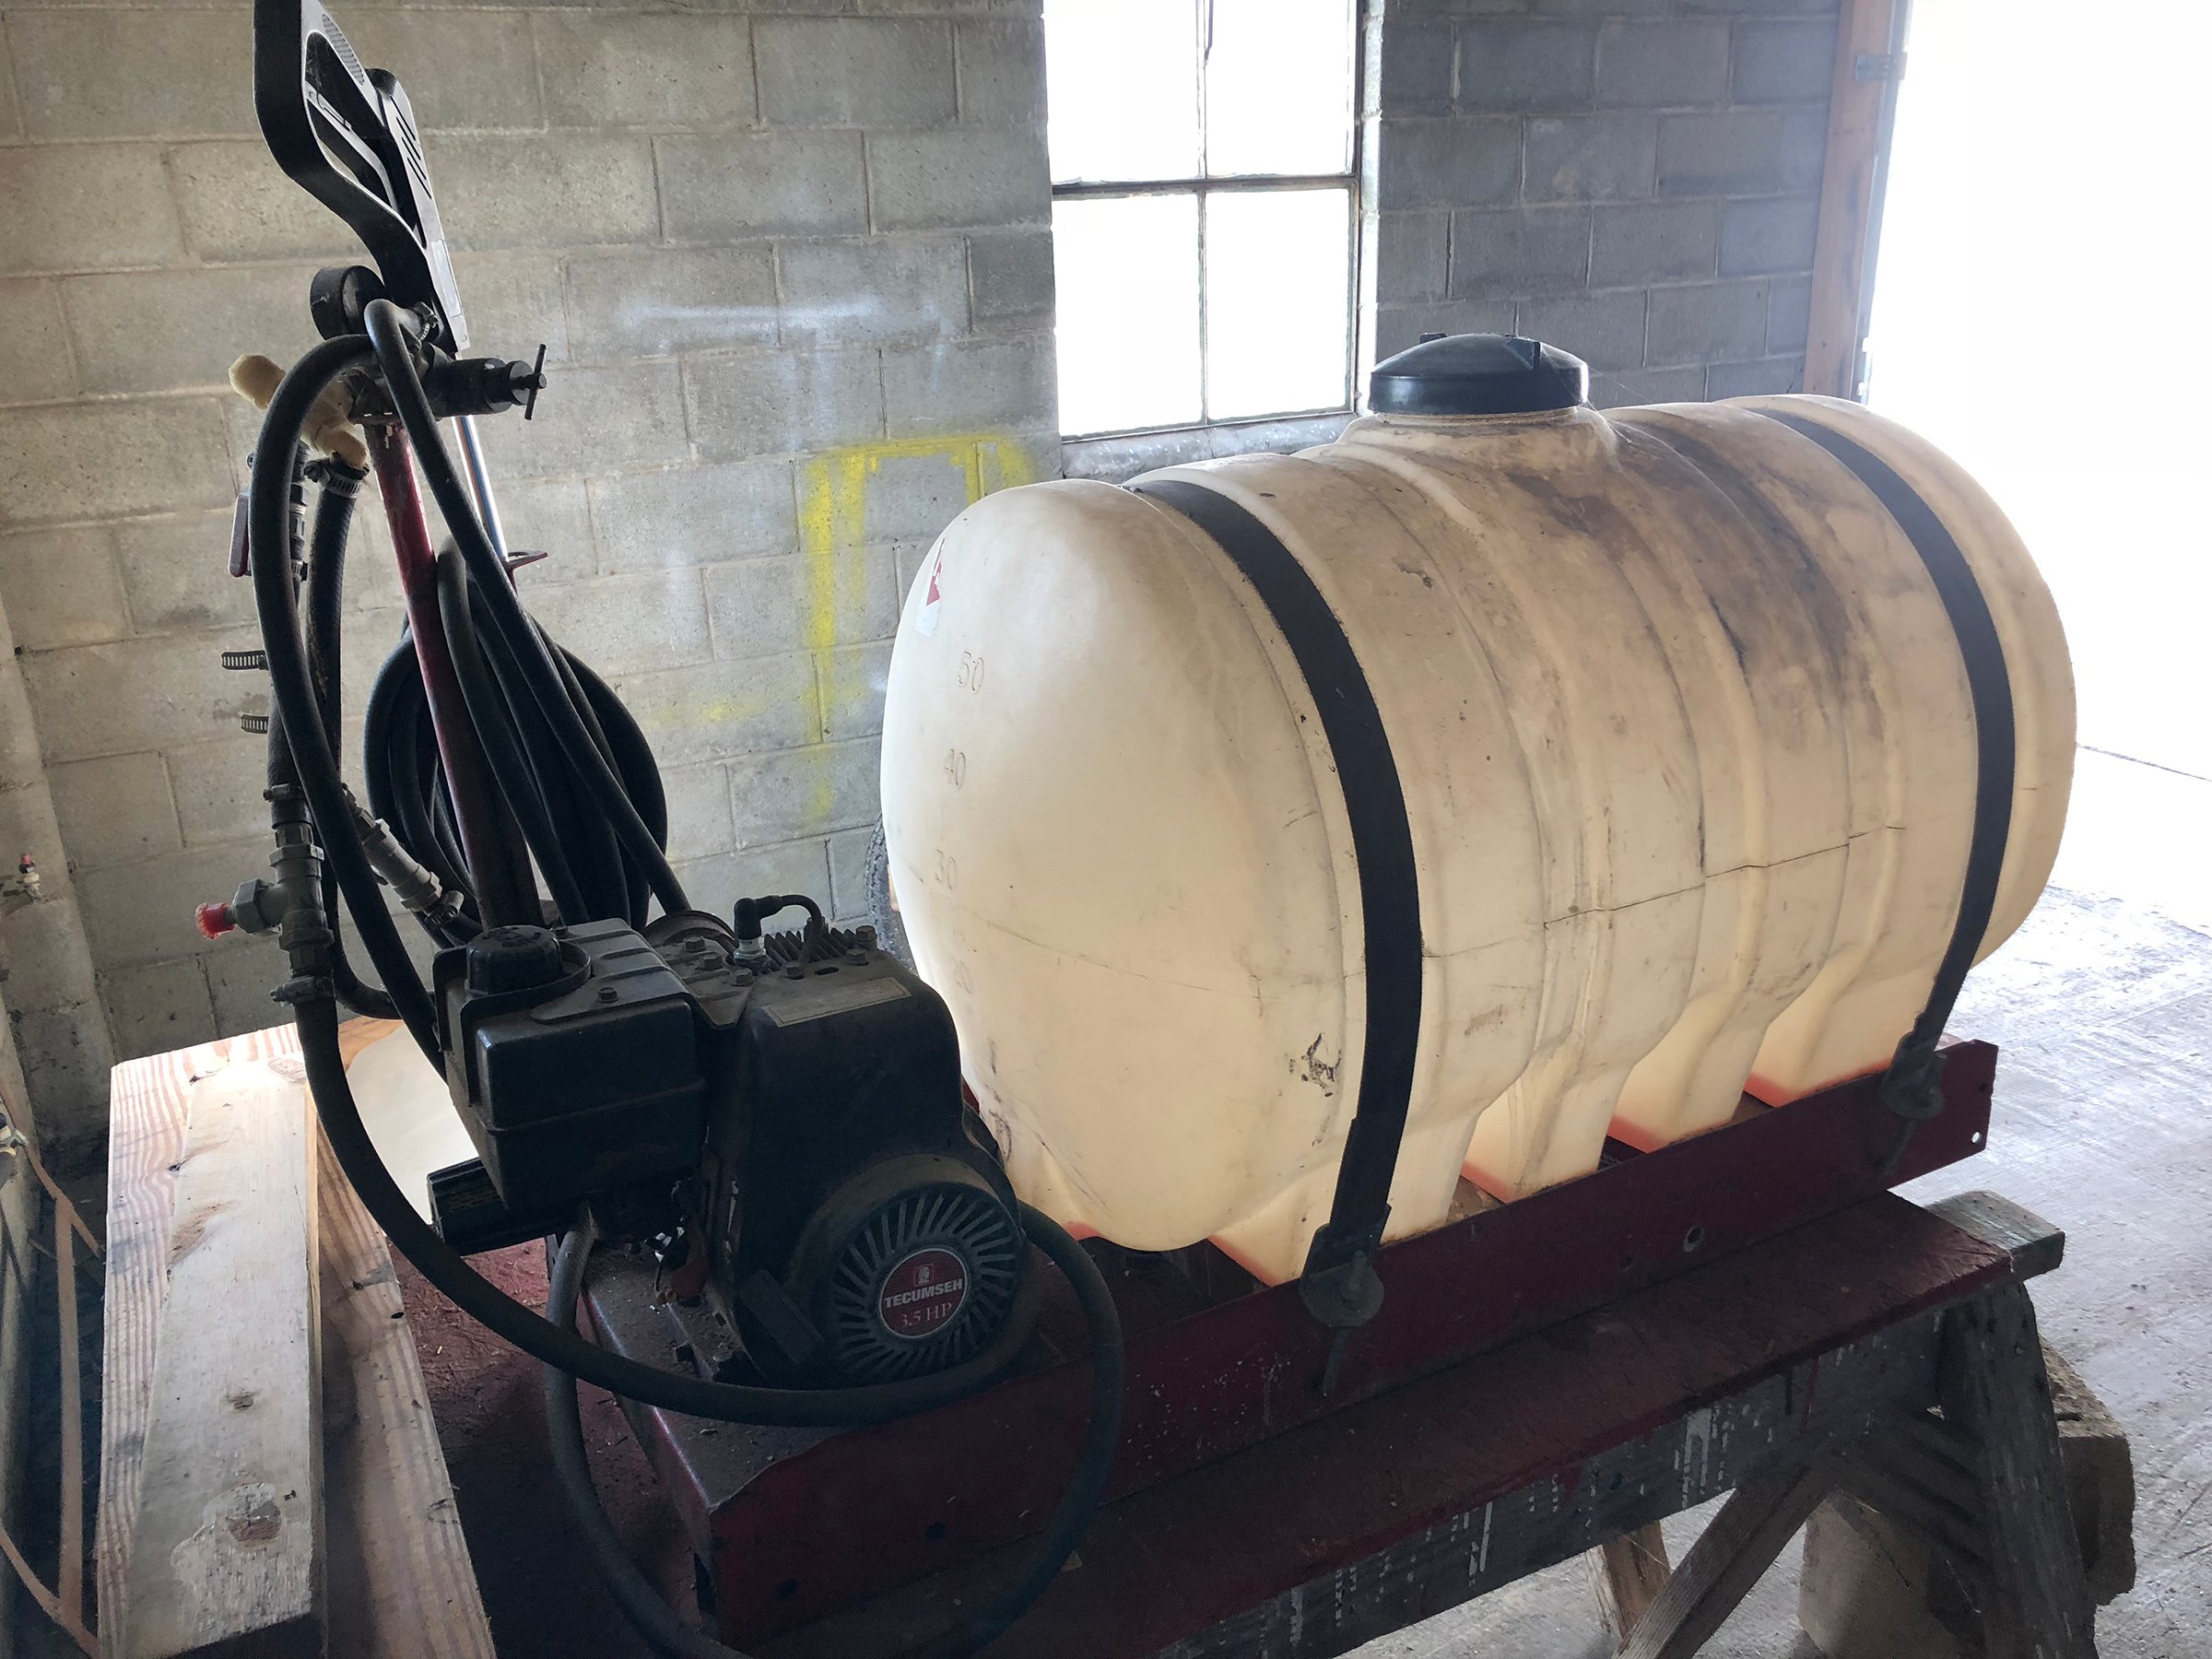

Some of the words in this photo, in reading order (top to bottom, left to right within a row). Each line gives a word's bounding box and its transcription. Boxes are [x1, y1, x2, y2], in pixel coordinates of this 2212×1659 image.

[957, 650, 985, 695] 50
[943, 747, 967, 791] 40
[884, 1277, 963, 1309] TECUMSEH
[901, 1310, 922, 1327] 3.5
[926, 1301, 952, 1322] HP
